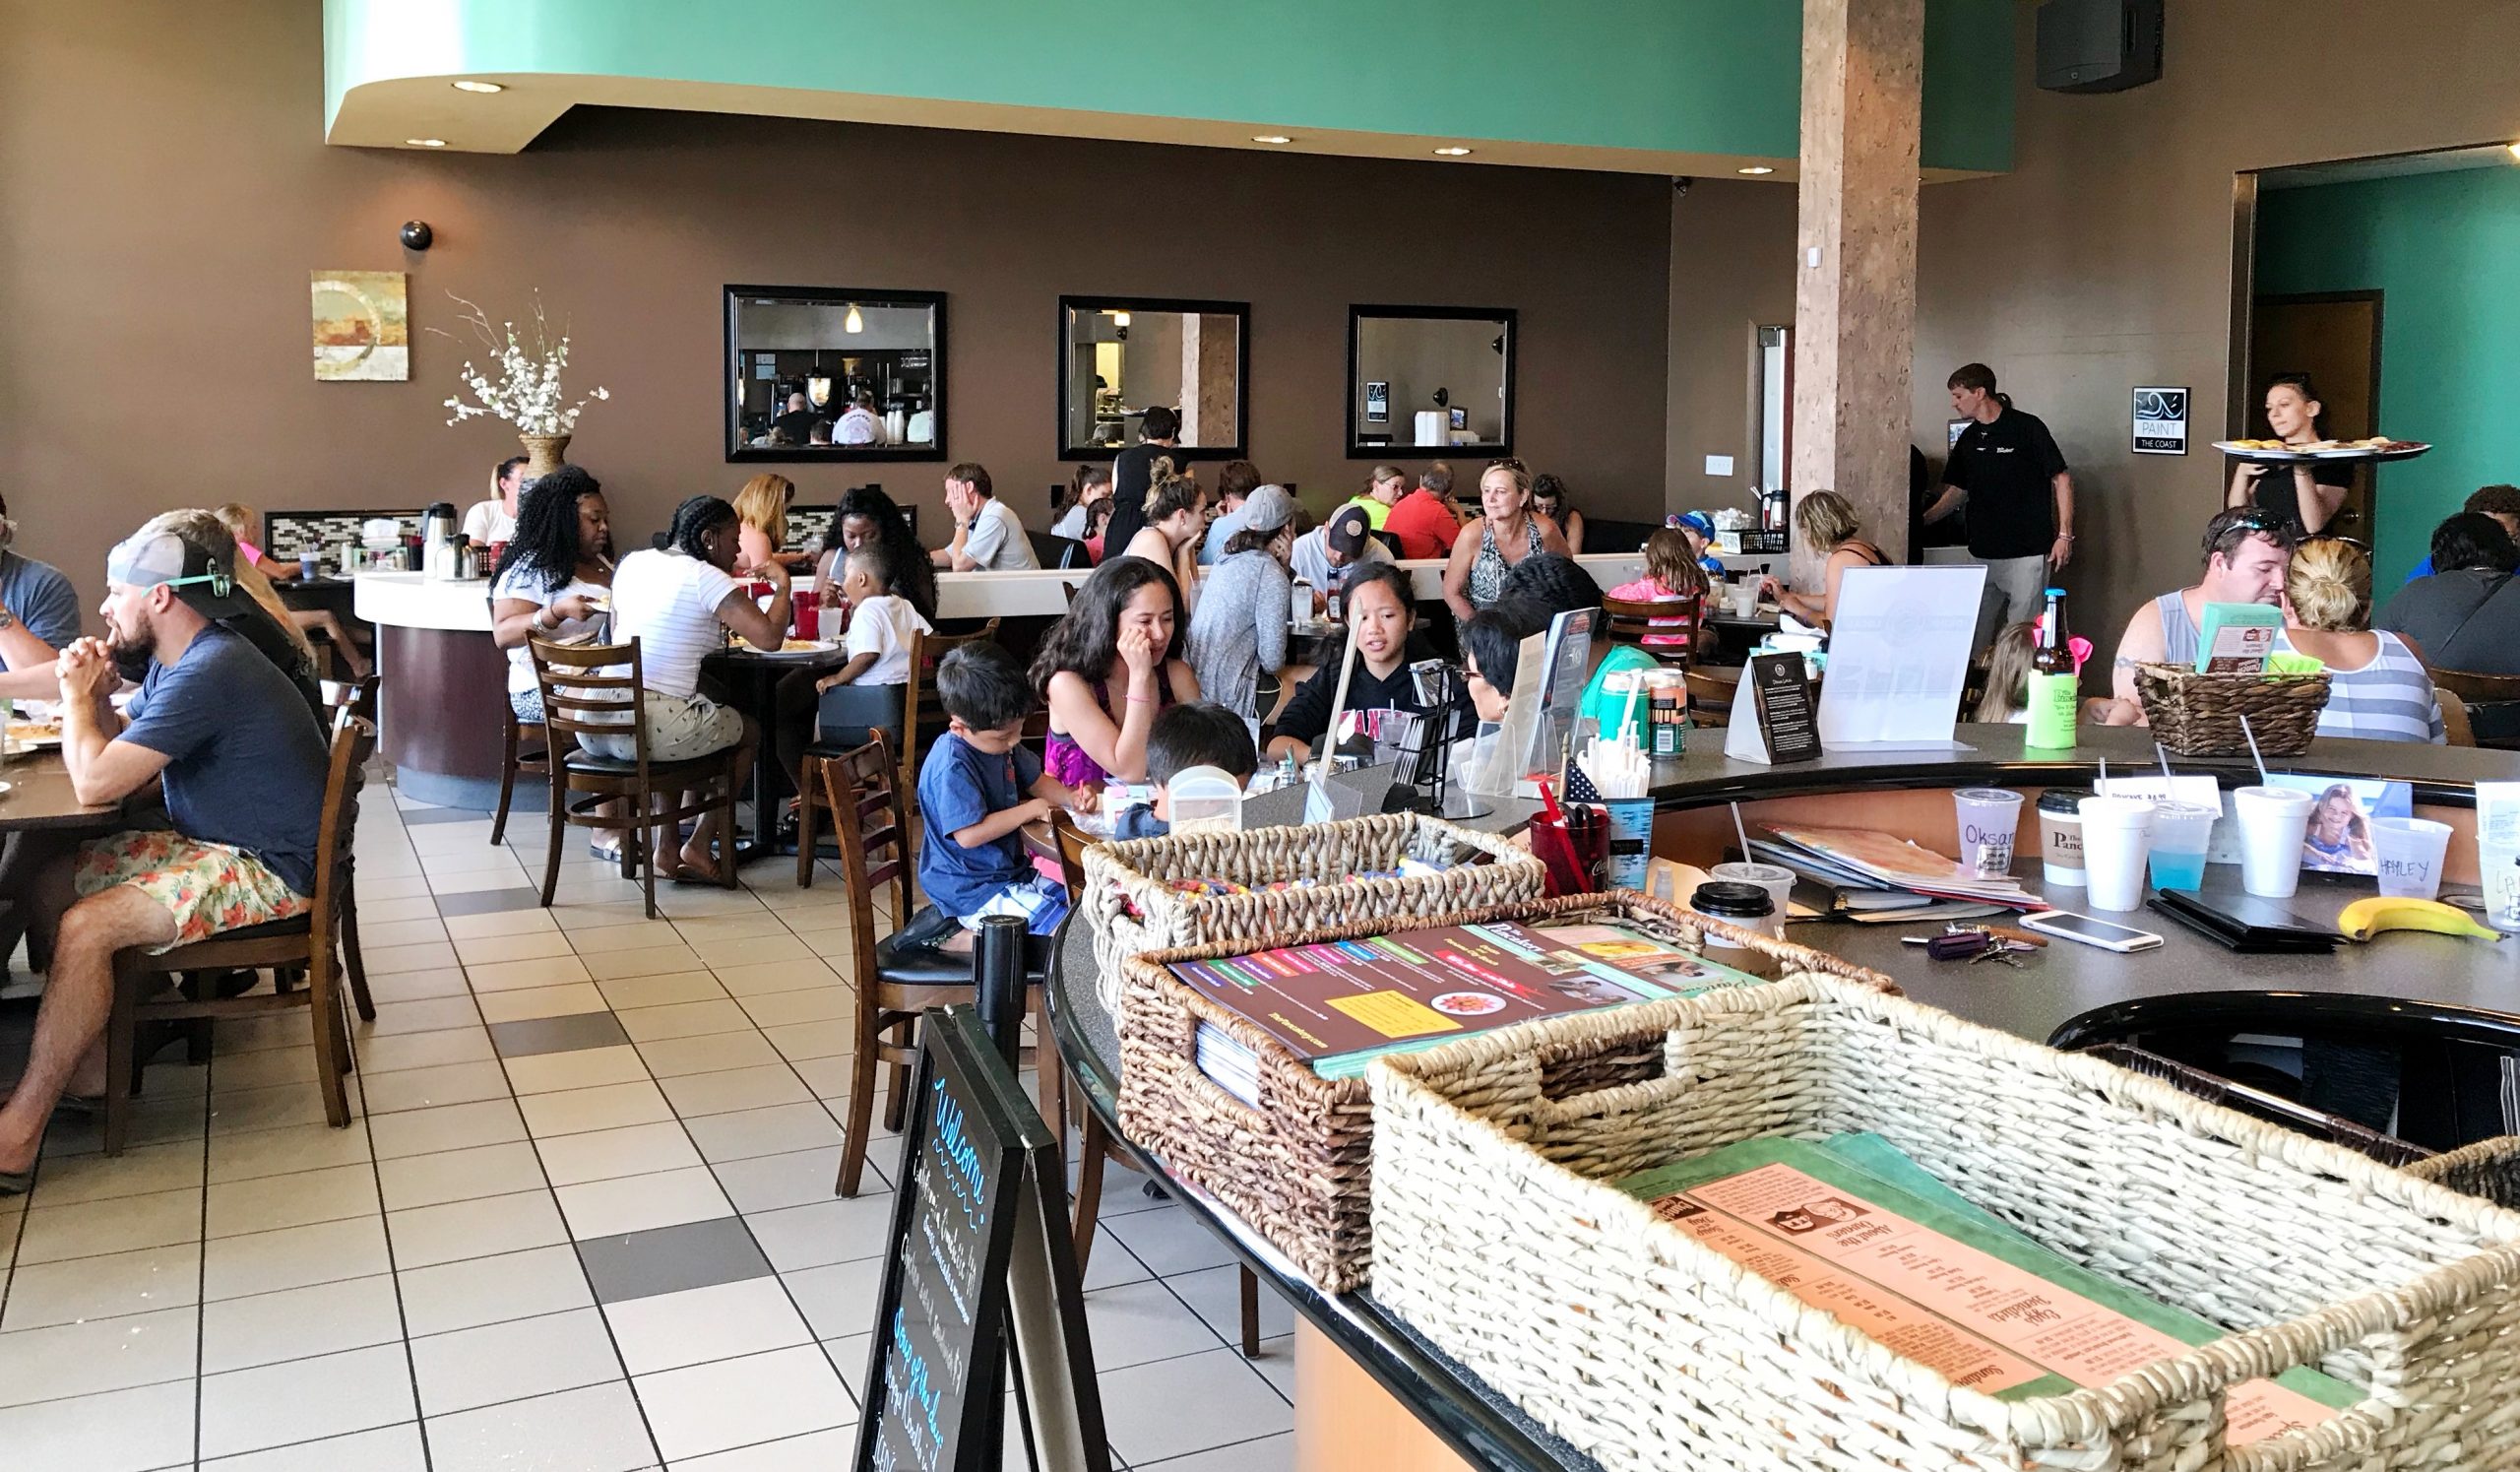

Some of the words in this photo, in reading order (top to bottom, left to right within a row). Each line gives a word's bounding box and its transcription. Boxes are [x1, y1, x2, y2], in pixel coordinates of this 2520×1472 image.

[2142, 421, 2177, 436] PAINT
[2141, 439, 2154, 448] THE
[2155, 440, 2177, 449] COAST
[2053, 831, 2084, 851] Panc
[2380, 859, 2429, 882] HAYLEY
[1481, 923, 1546, 952] Pancakery
[1686, 1216, 1715, 1226] Day
[1826, 1220, 1875, 1240] Owners
[1696, 1225, 1725, 1237] Soup
[1864, 1224, 1894, 1242] About
[1837, 1235, 1862, 1248] the
[1986, 1295, 2052, 1323] Benedicts
[2024, 1308, 2062, 1327] Eggs
[894, 1307, 913, 1374] Soup
[911, 1354, 922, 1400] of
[918, 1362, 930, 1413] the
